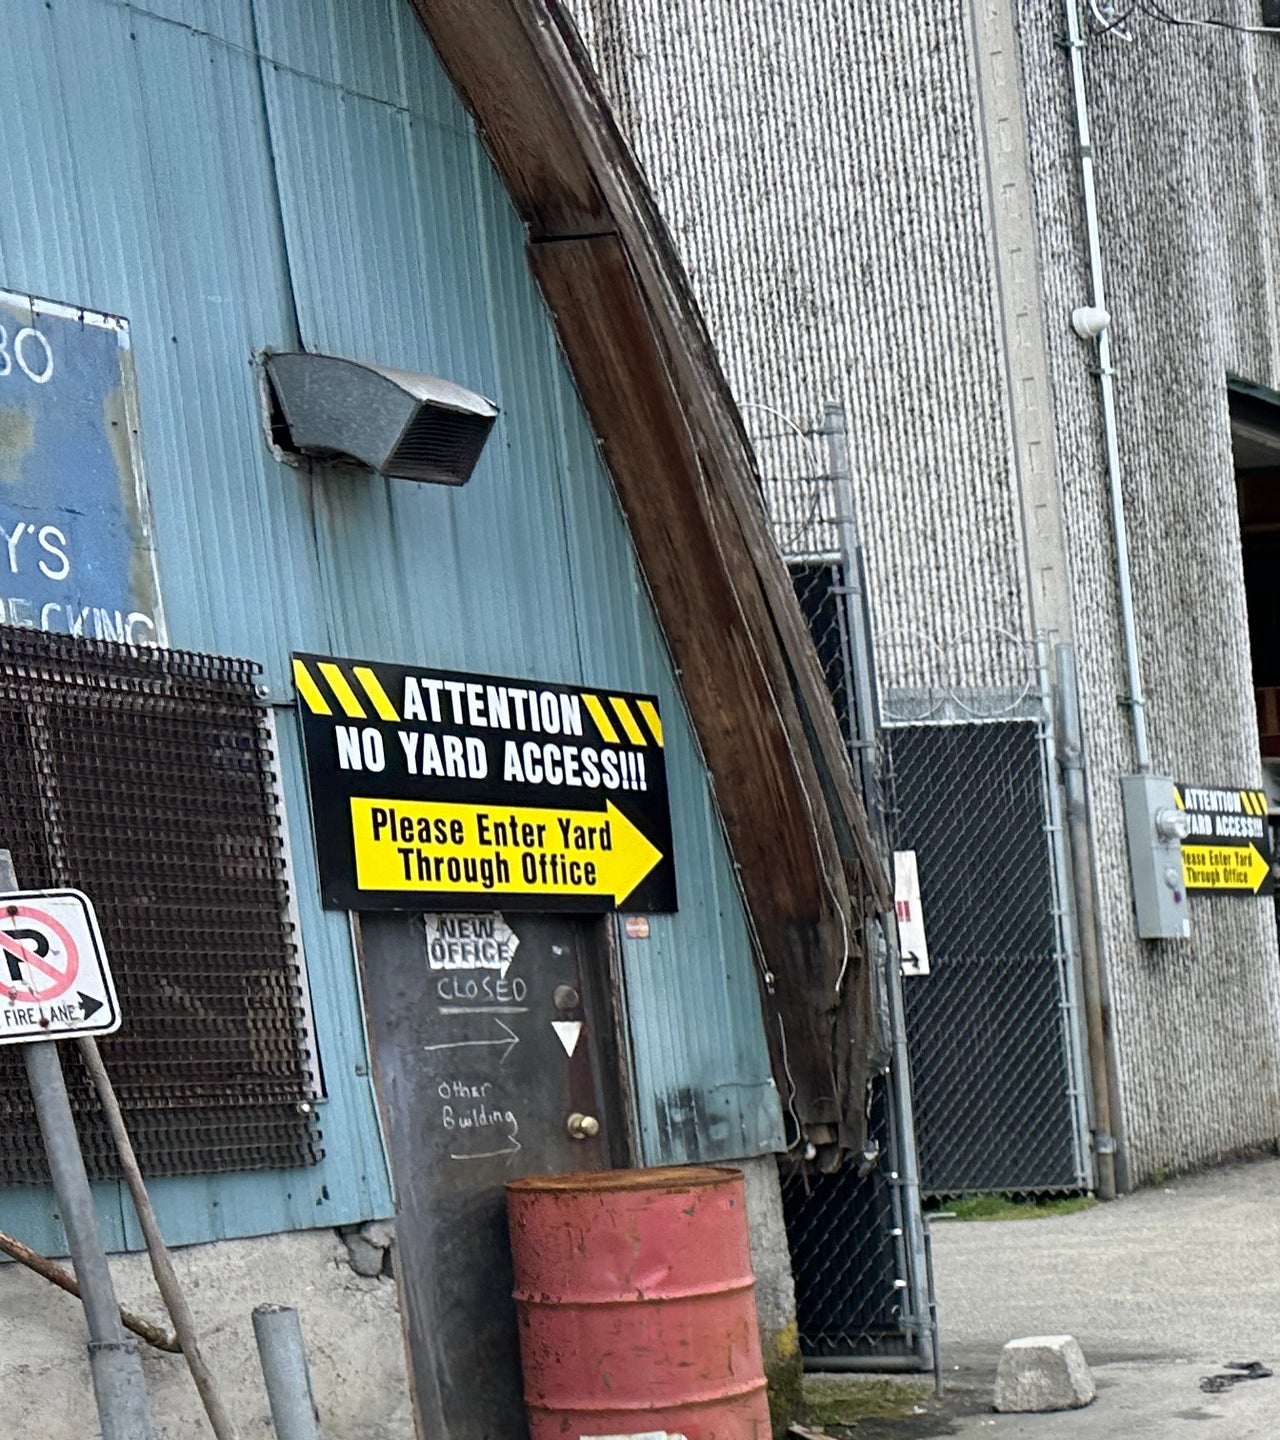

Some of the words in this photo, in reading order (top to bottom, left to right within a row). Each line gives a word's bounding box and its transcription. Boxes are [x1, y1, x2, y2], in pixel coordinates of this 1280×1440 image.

[0, 597, 156, 650] ECKING
[403, 676, 583, 736] ATTENTION
[335, 725, 386, 773] NO
[398, 731, 488, 780] YARD
[503, 740, 647, 791] ACCESS!!!
[1184, 788, 1242, 813] ATTENTION
[371, 807, 464, 844] Please
[476, 813, 546, 849] Enter
[557, 817, 613, 851] Yard
[1215, 815, 1264, 838] ACCESS!!!
[397, 847, 510, 889] Through
[523, 852, 597, 886] Office
[1181, 850, 1206, 866] lease
[1208, 850, 1232, 866] Enter
[1234, 851, 1252, 867] Yard
[1186, 867, 1221, 886] Through
[1223, 867, 1248, 884] Office
[439, 919, 494, 939] NEW
[431, 937, 509, 963] OFFICE
[437, 975, 527, 1002] CLOSED
[4, 1007, 38, 1027] FIRE
[442, 1105, 519, 1136] Building
